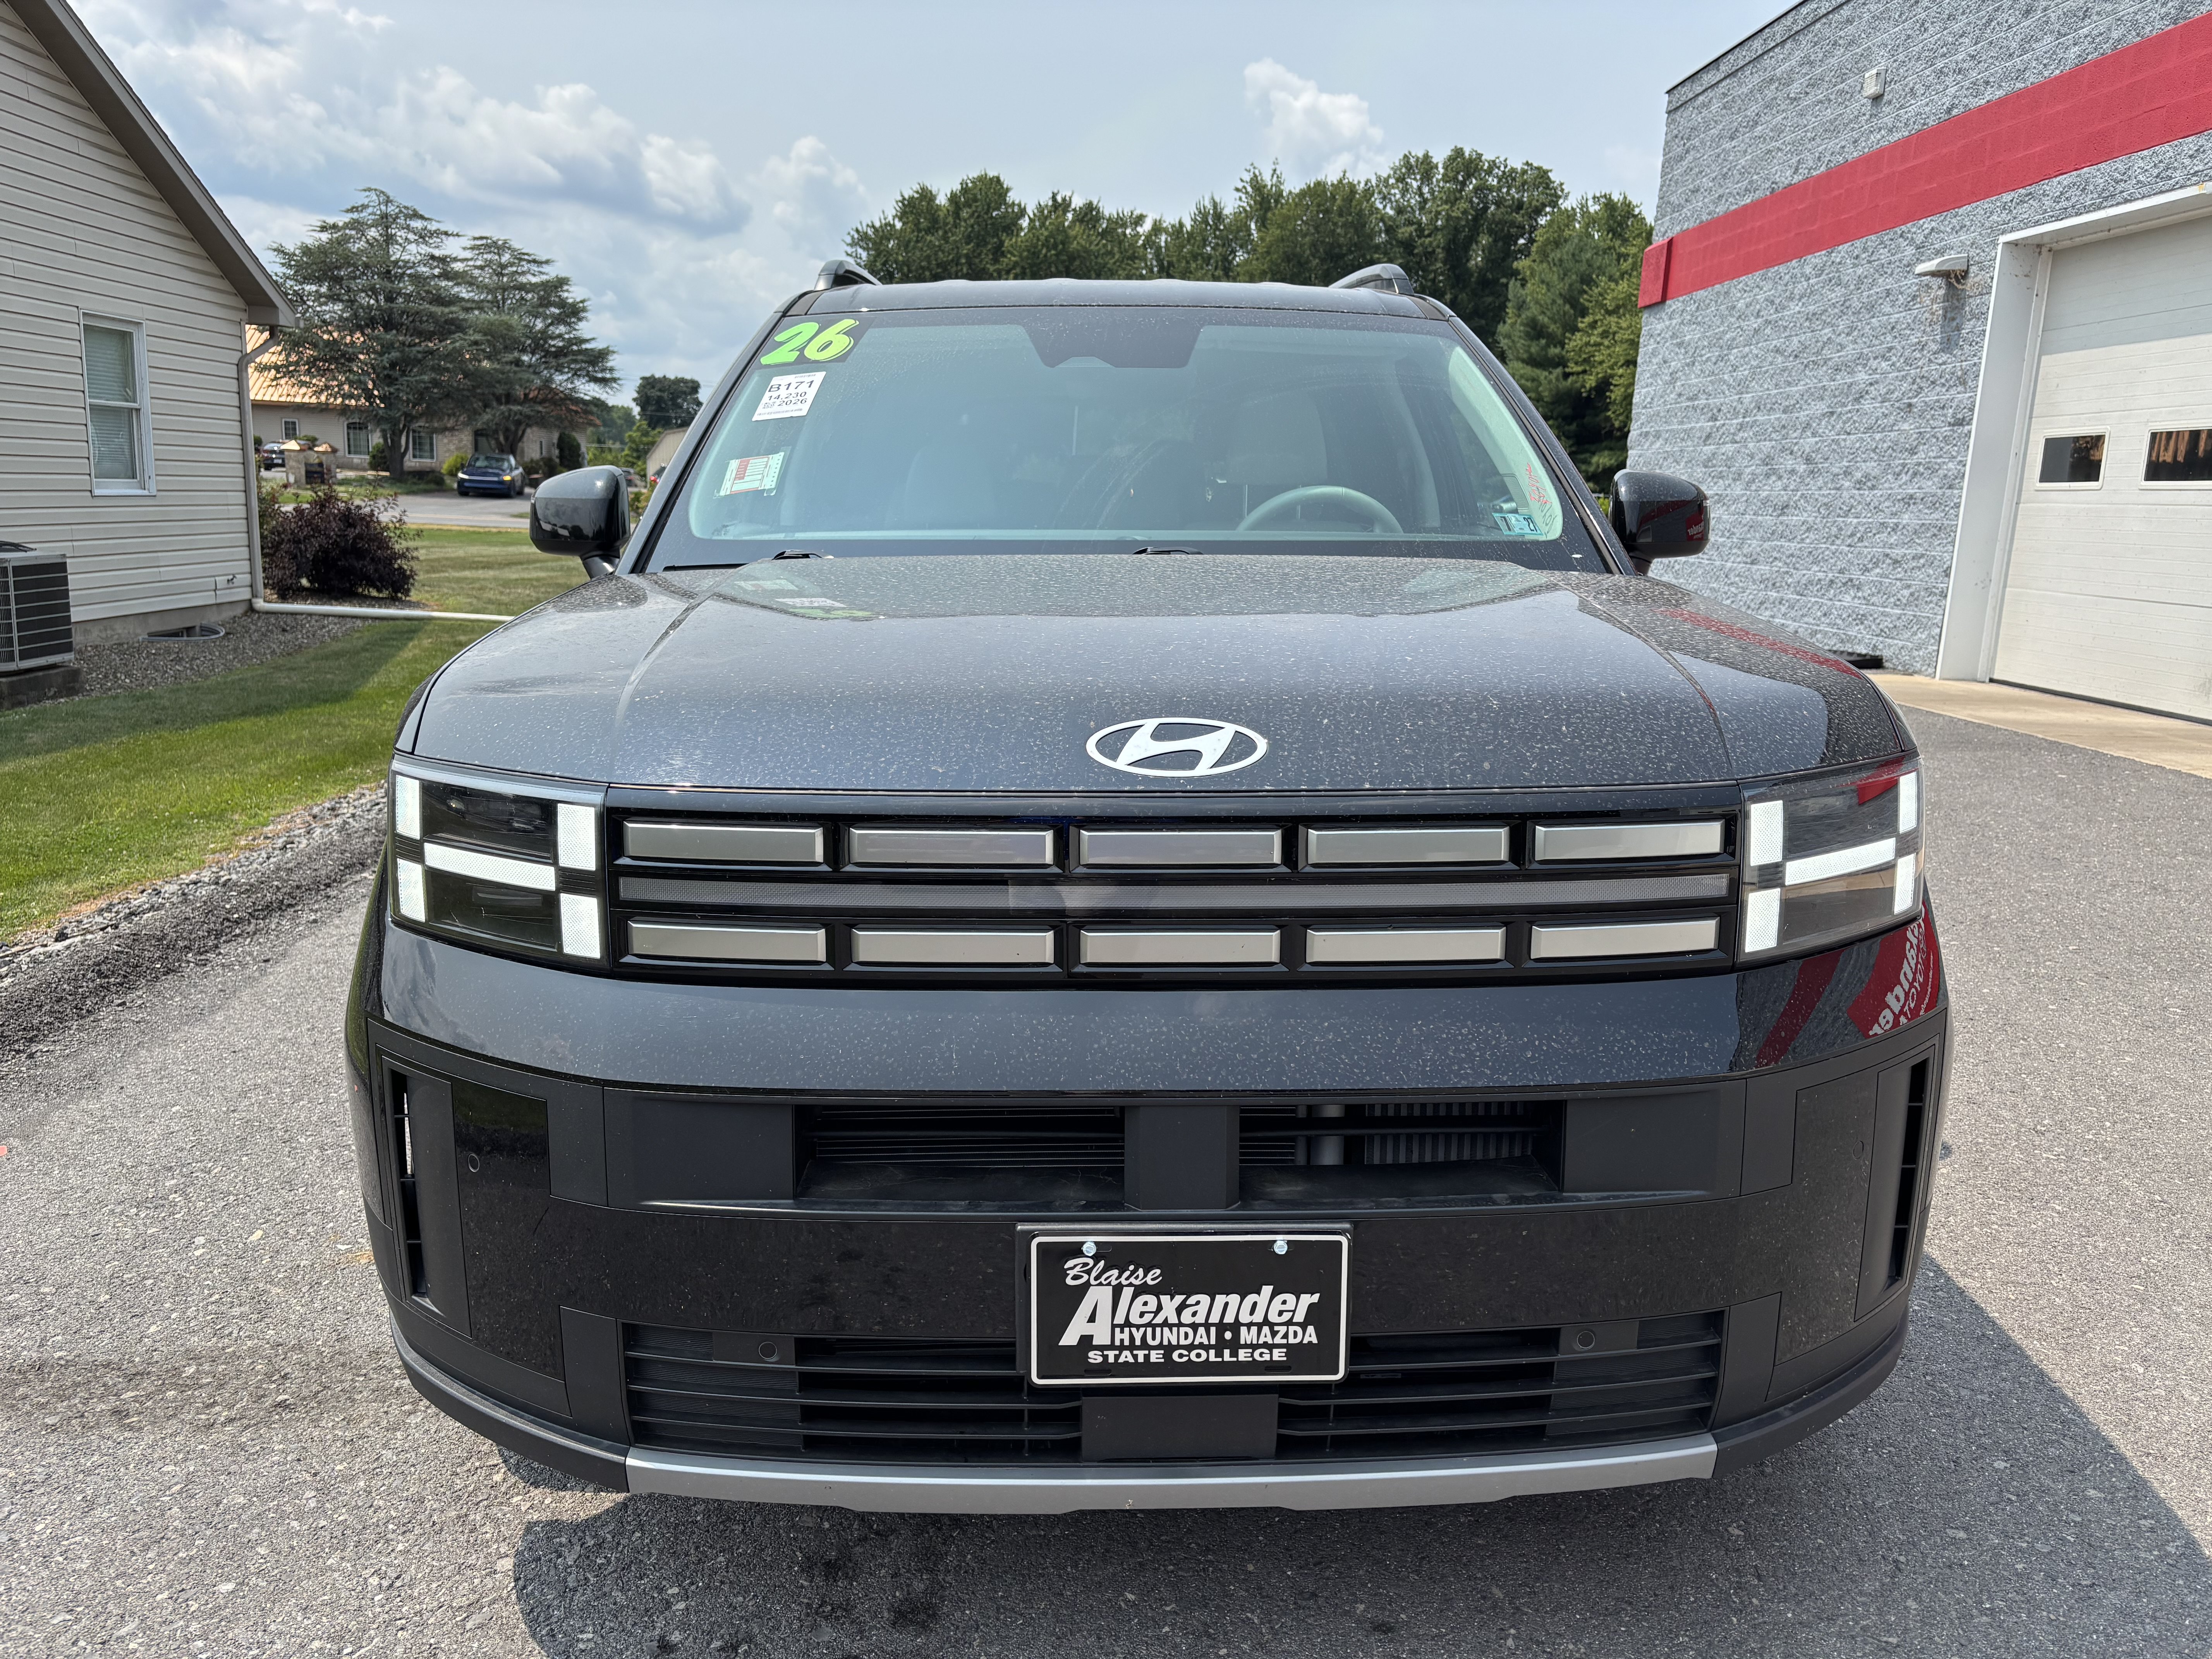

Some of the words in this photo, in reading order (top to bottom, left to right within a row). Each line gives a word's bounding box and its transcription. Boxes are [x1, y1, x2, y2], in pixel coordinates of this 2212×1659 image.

[760, 319, 859, 365] 26
[768, 380, 814, 392] B171
[777, 398, 807, 406] 2026
[1523, 517, 1537, 533] 27
[1064, 1257, 1162, 1285] Blaise
[1058, 1285, 1320, 1346] Alexander
[1115, 1327, 1216, 1345] HYUNDAI
[1240, 1326, 1317, 1344] MAZDA
[1088, 1350, 1164, 1363] STATE
[1172, 1349, 1286, 1362] COLLEGE
